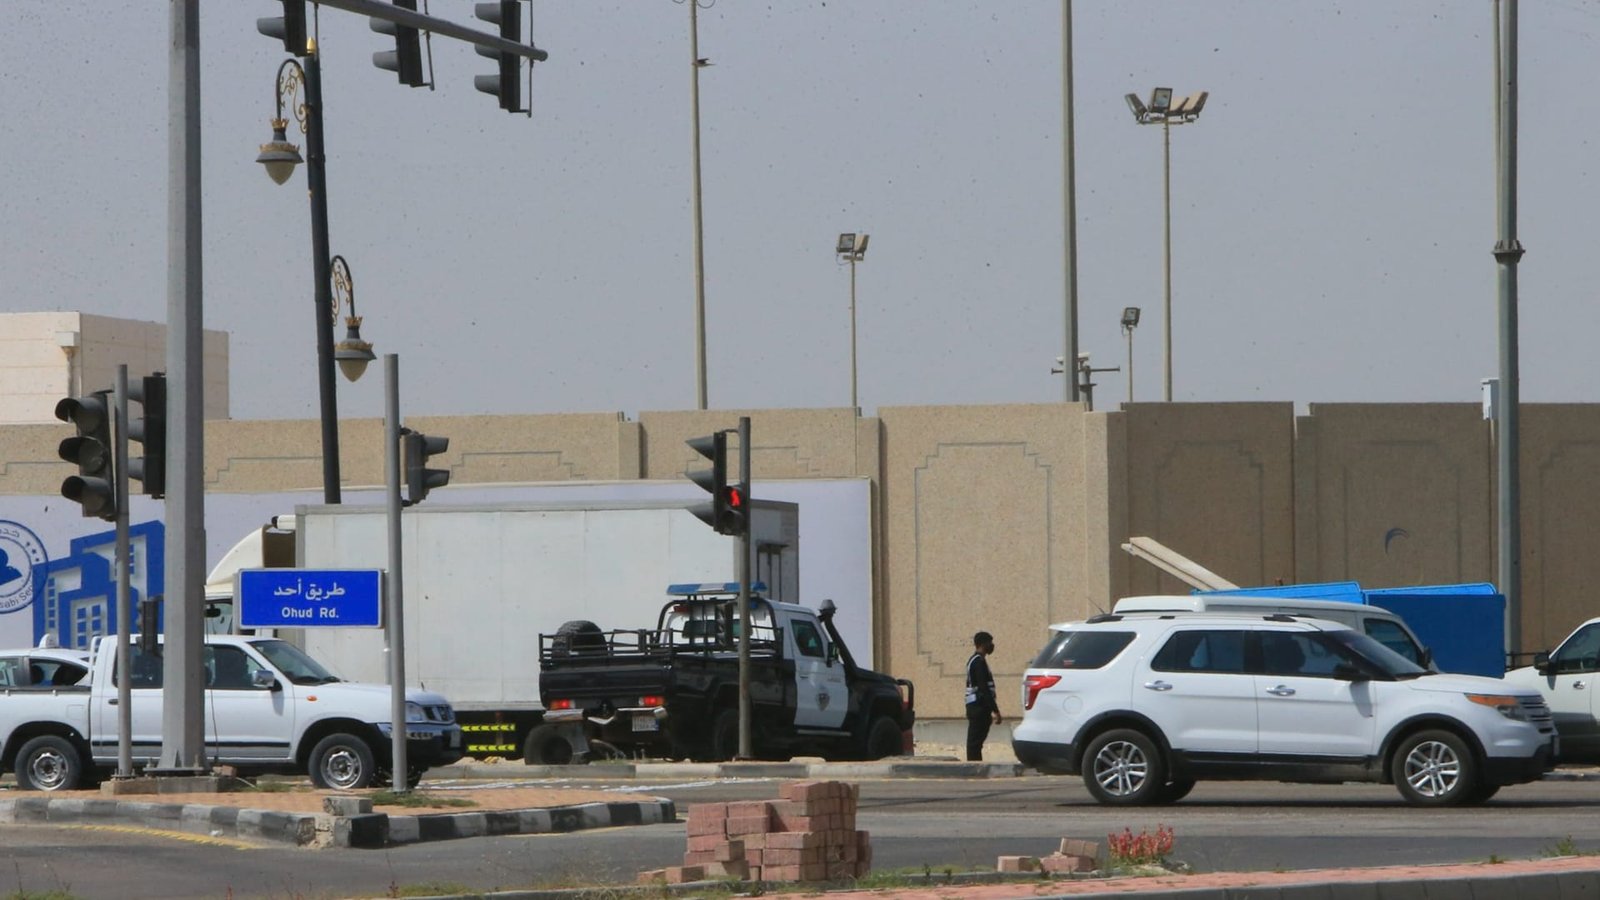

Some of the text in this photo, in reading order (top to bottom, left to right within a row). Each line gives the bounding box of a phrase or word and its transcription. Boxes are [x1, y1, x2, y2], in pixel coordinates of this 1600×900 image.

[274, 578, 346, 601] طريق أحد
[281, 606, 339, 618] Ohud Rd.
